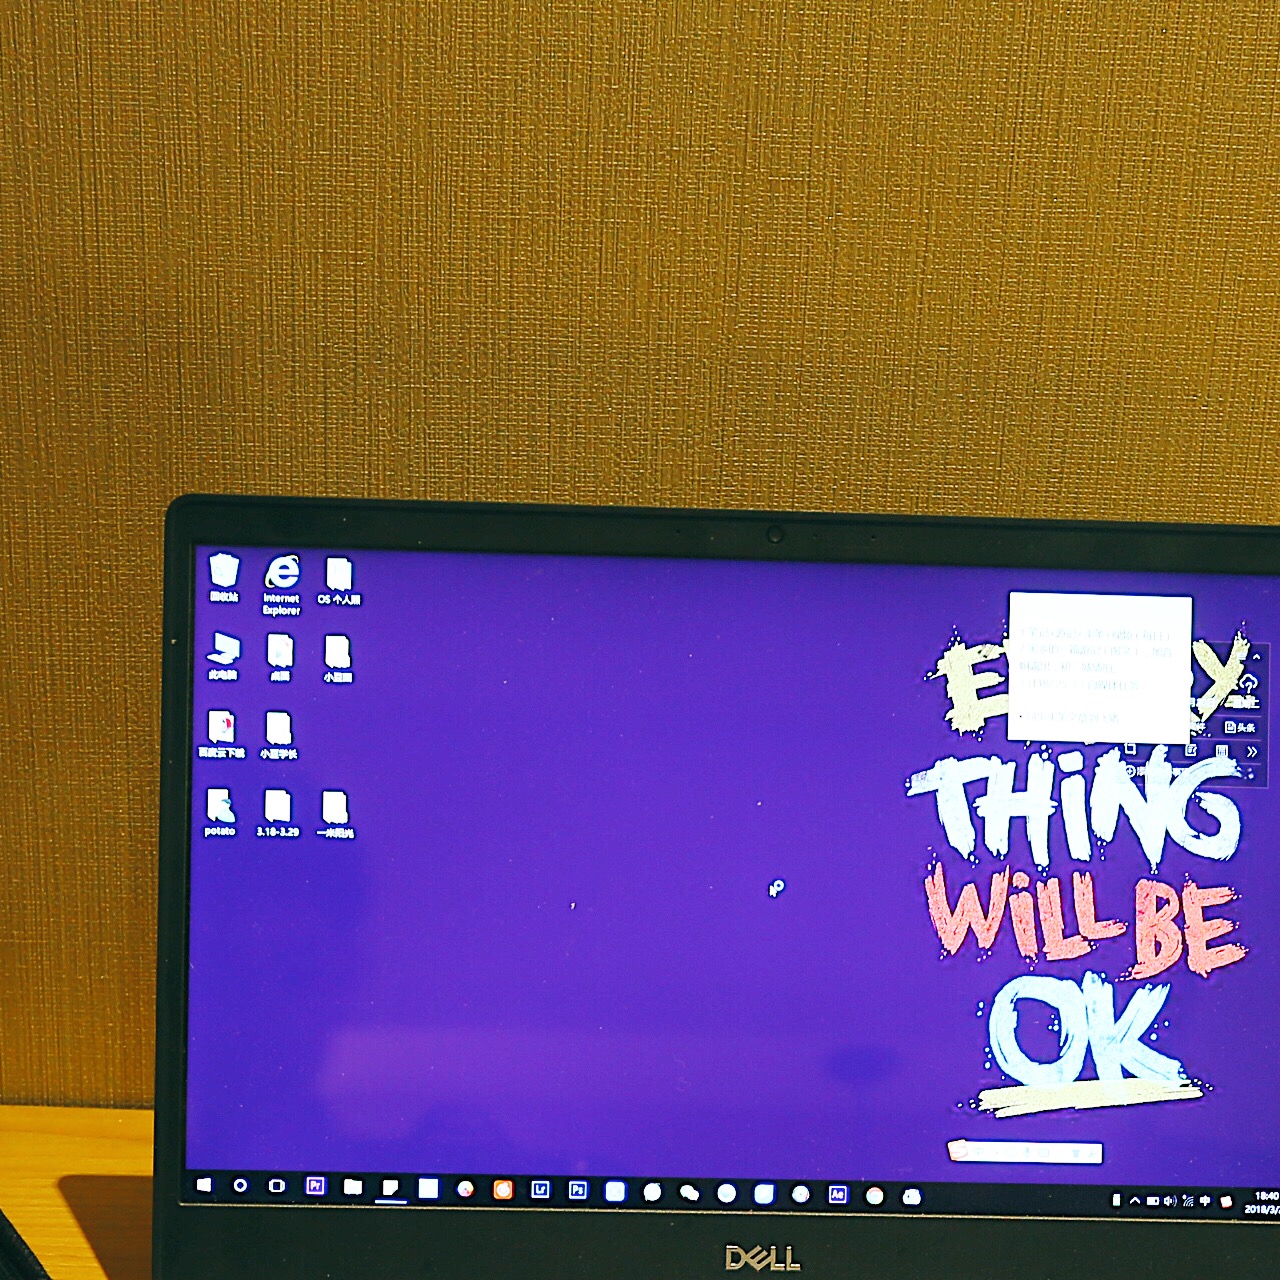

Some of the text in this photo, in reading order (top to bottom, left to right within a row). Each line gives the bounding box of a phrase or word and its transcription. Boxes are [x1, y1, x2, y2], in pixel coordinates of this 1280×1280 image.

[263, 592, 300, 604] Internet
[262, 605, 301, 617] Explorer
[204, 827, 236, 838] potato
[1120, 877, 1249, 980] BE
[988, 970, 1184, 1090] OK
[725, 1244, 801, 1272] DELL
